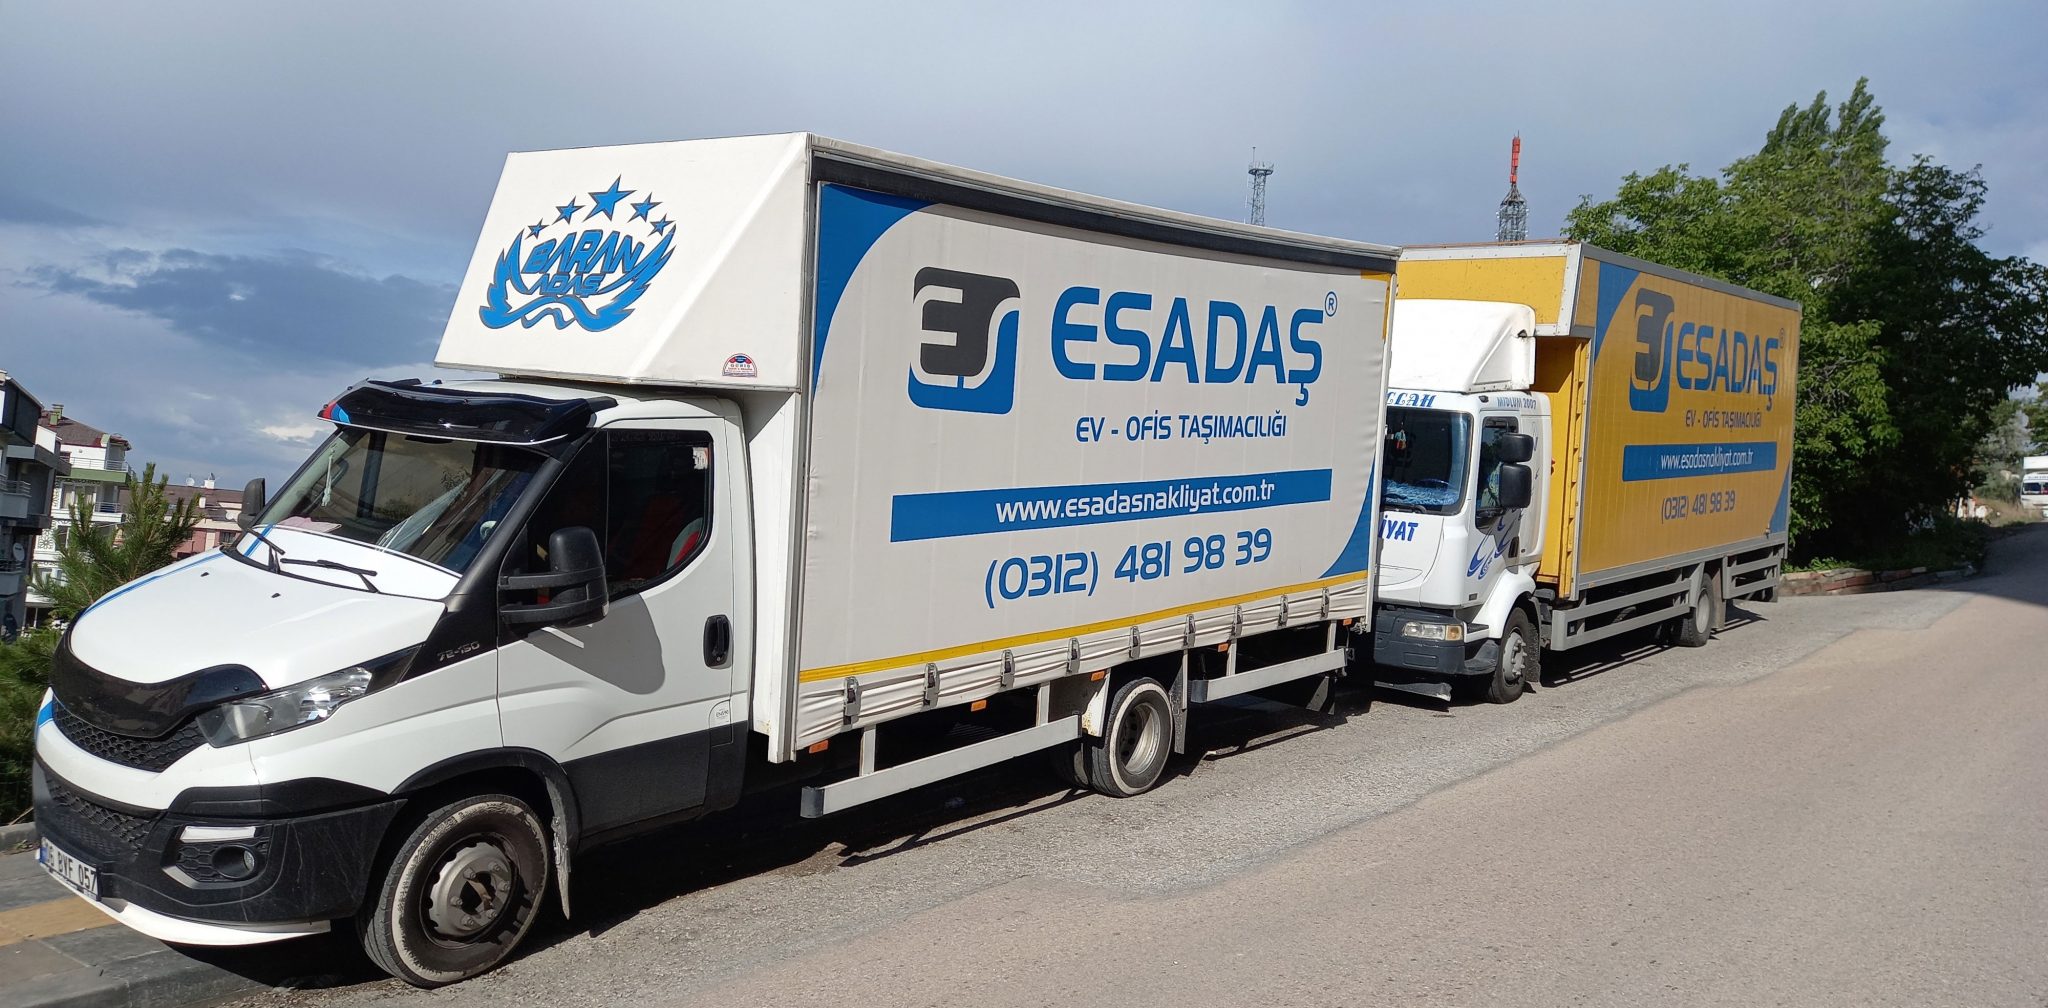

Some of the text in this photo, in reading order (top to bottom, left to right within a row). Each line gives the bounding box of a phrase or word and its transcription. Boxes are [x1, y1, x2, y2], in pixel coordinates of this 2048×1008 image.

[521, 229, 645, 274] BARAN
[1051, 286, 1324, 407] ESADAŞ
[1676, 321, 1779, 411] ESADAŞ
[1076, 416, 1105, 442] EV
[1126, 410, 1171, 441] OFİS
[1178, 410, 1287, 444] TAŞIMACILIĞI
[1685, 409, 1697, 428] EV
[1702, 407, 1720, 428] OFİS
[1660, 446, 1754, 472] www.esadasnakliyat.com.tr
[996, 479, 1275, 523] www.esadasnakliyat.com.tr
[1661, 490, 1736, 525] (0312) 481 98 39
[985, 528, 1272, 609] (0312) 481 98 39
[78, 863, 98, 892] 057
